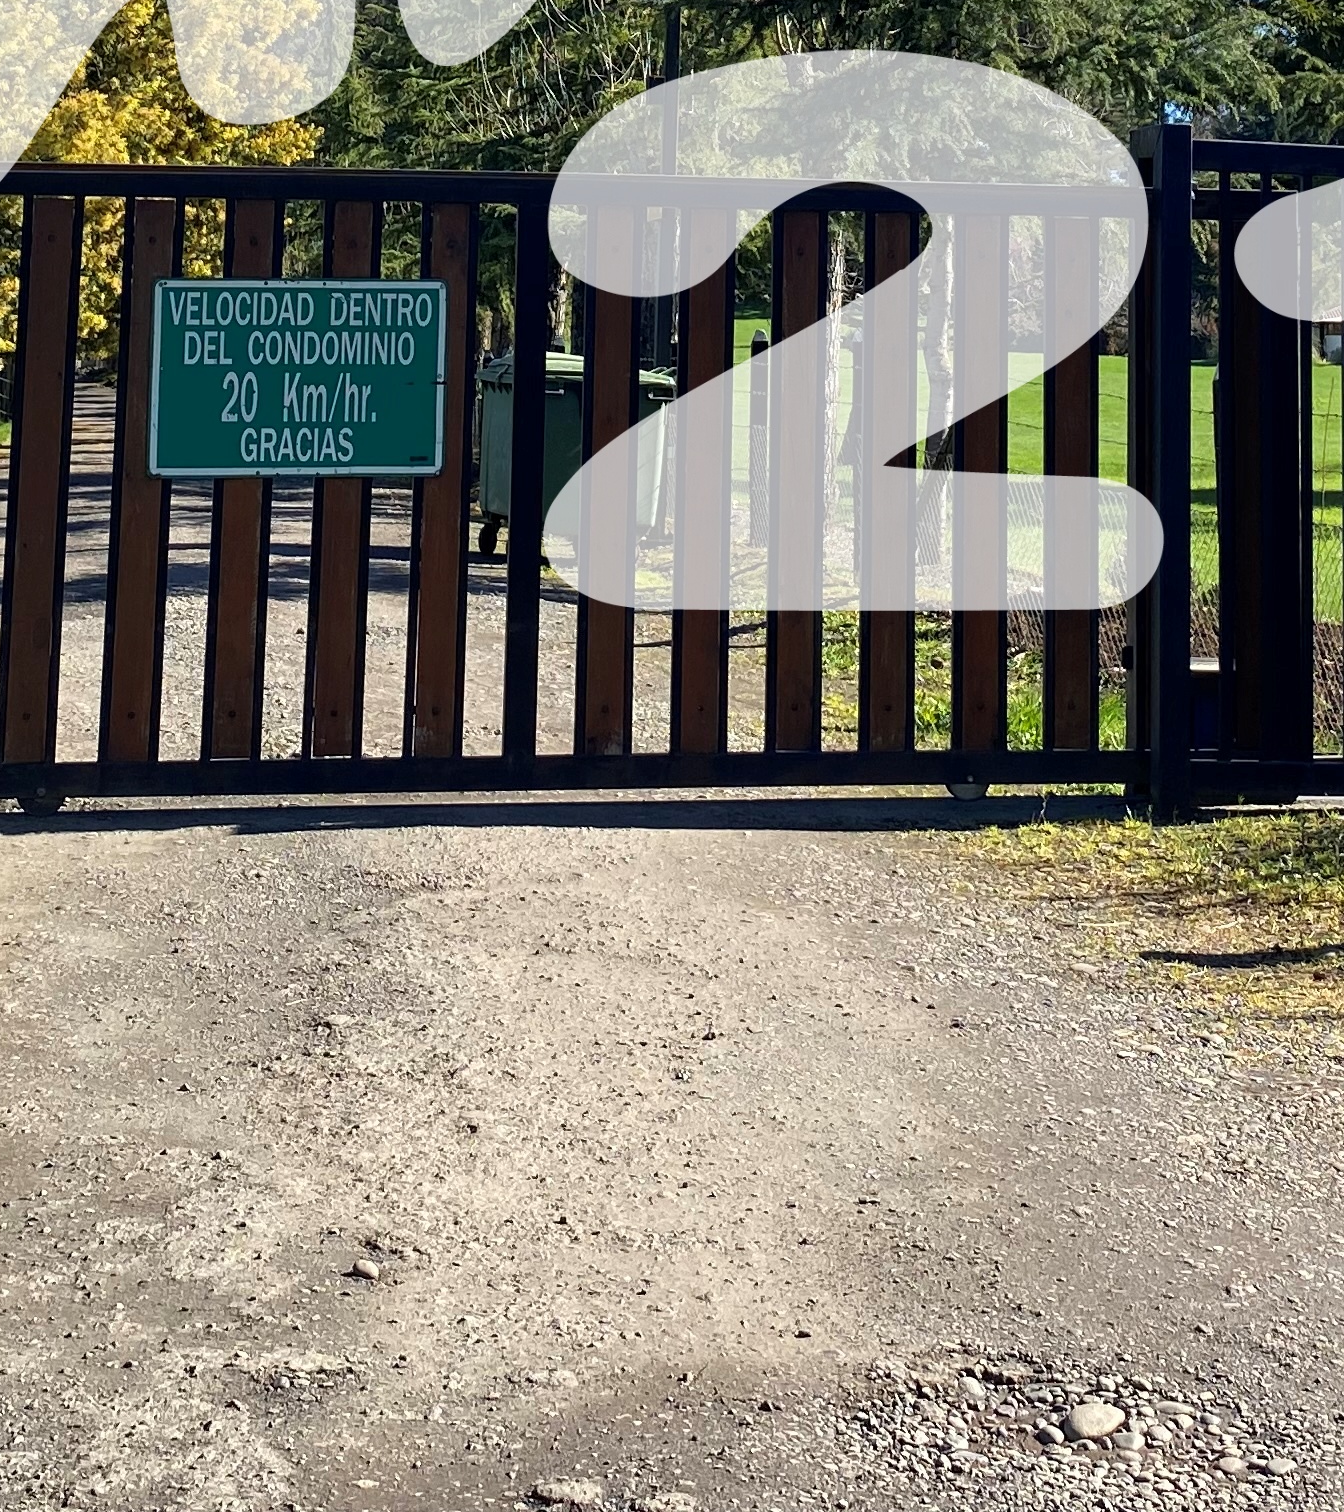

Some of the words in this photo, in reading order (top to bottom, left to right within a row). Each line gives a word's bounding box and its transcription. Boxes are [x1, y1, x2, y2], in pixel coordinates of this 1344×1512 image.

[168, 291, 315, 327] VELOCIDAD
[329, 292, 433, 327] DENTRO
[183, 331, 233, 365] DEL
[247, 330, 416, 366] CONDOMINIO
[220, 371, 259, 423] 20
[283, 372, 377, 423] Km/hr.
[240, 427, 355, 463] GRACIAS
